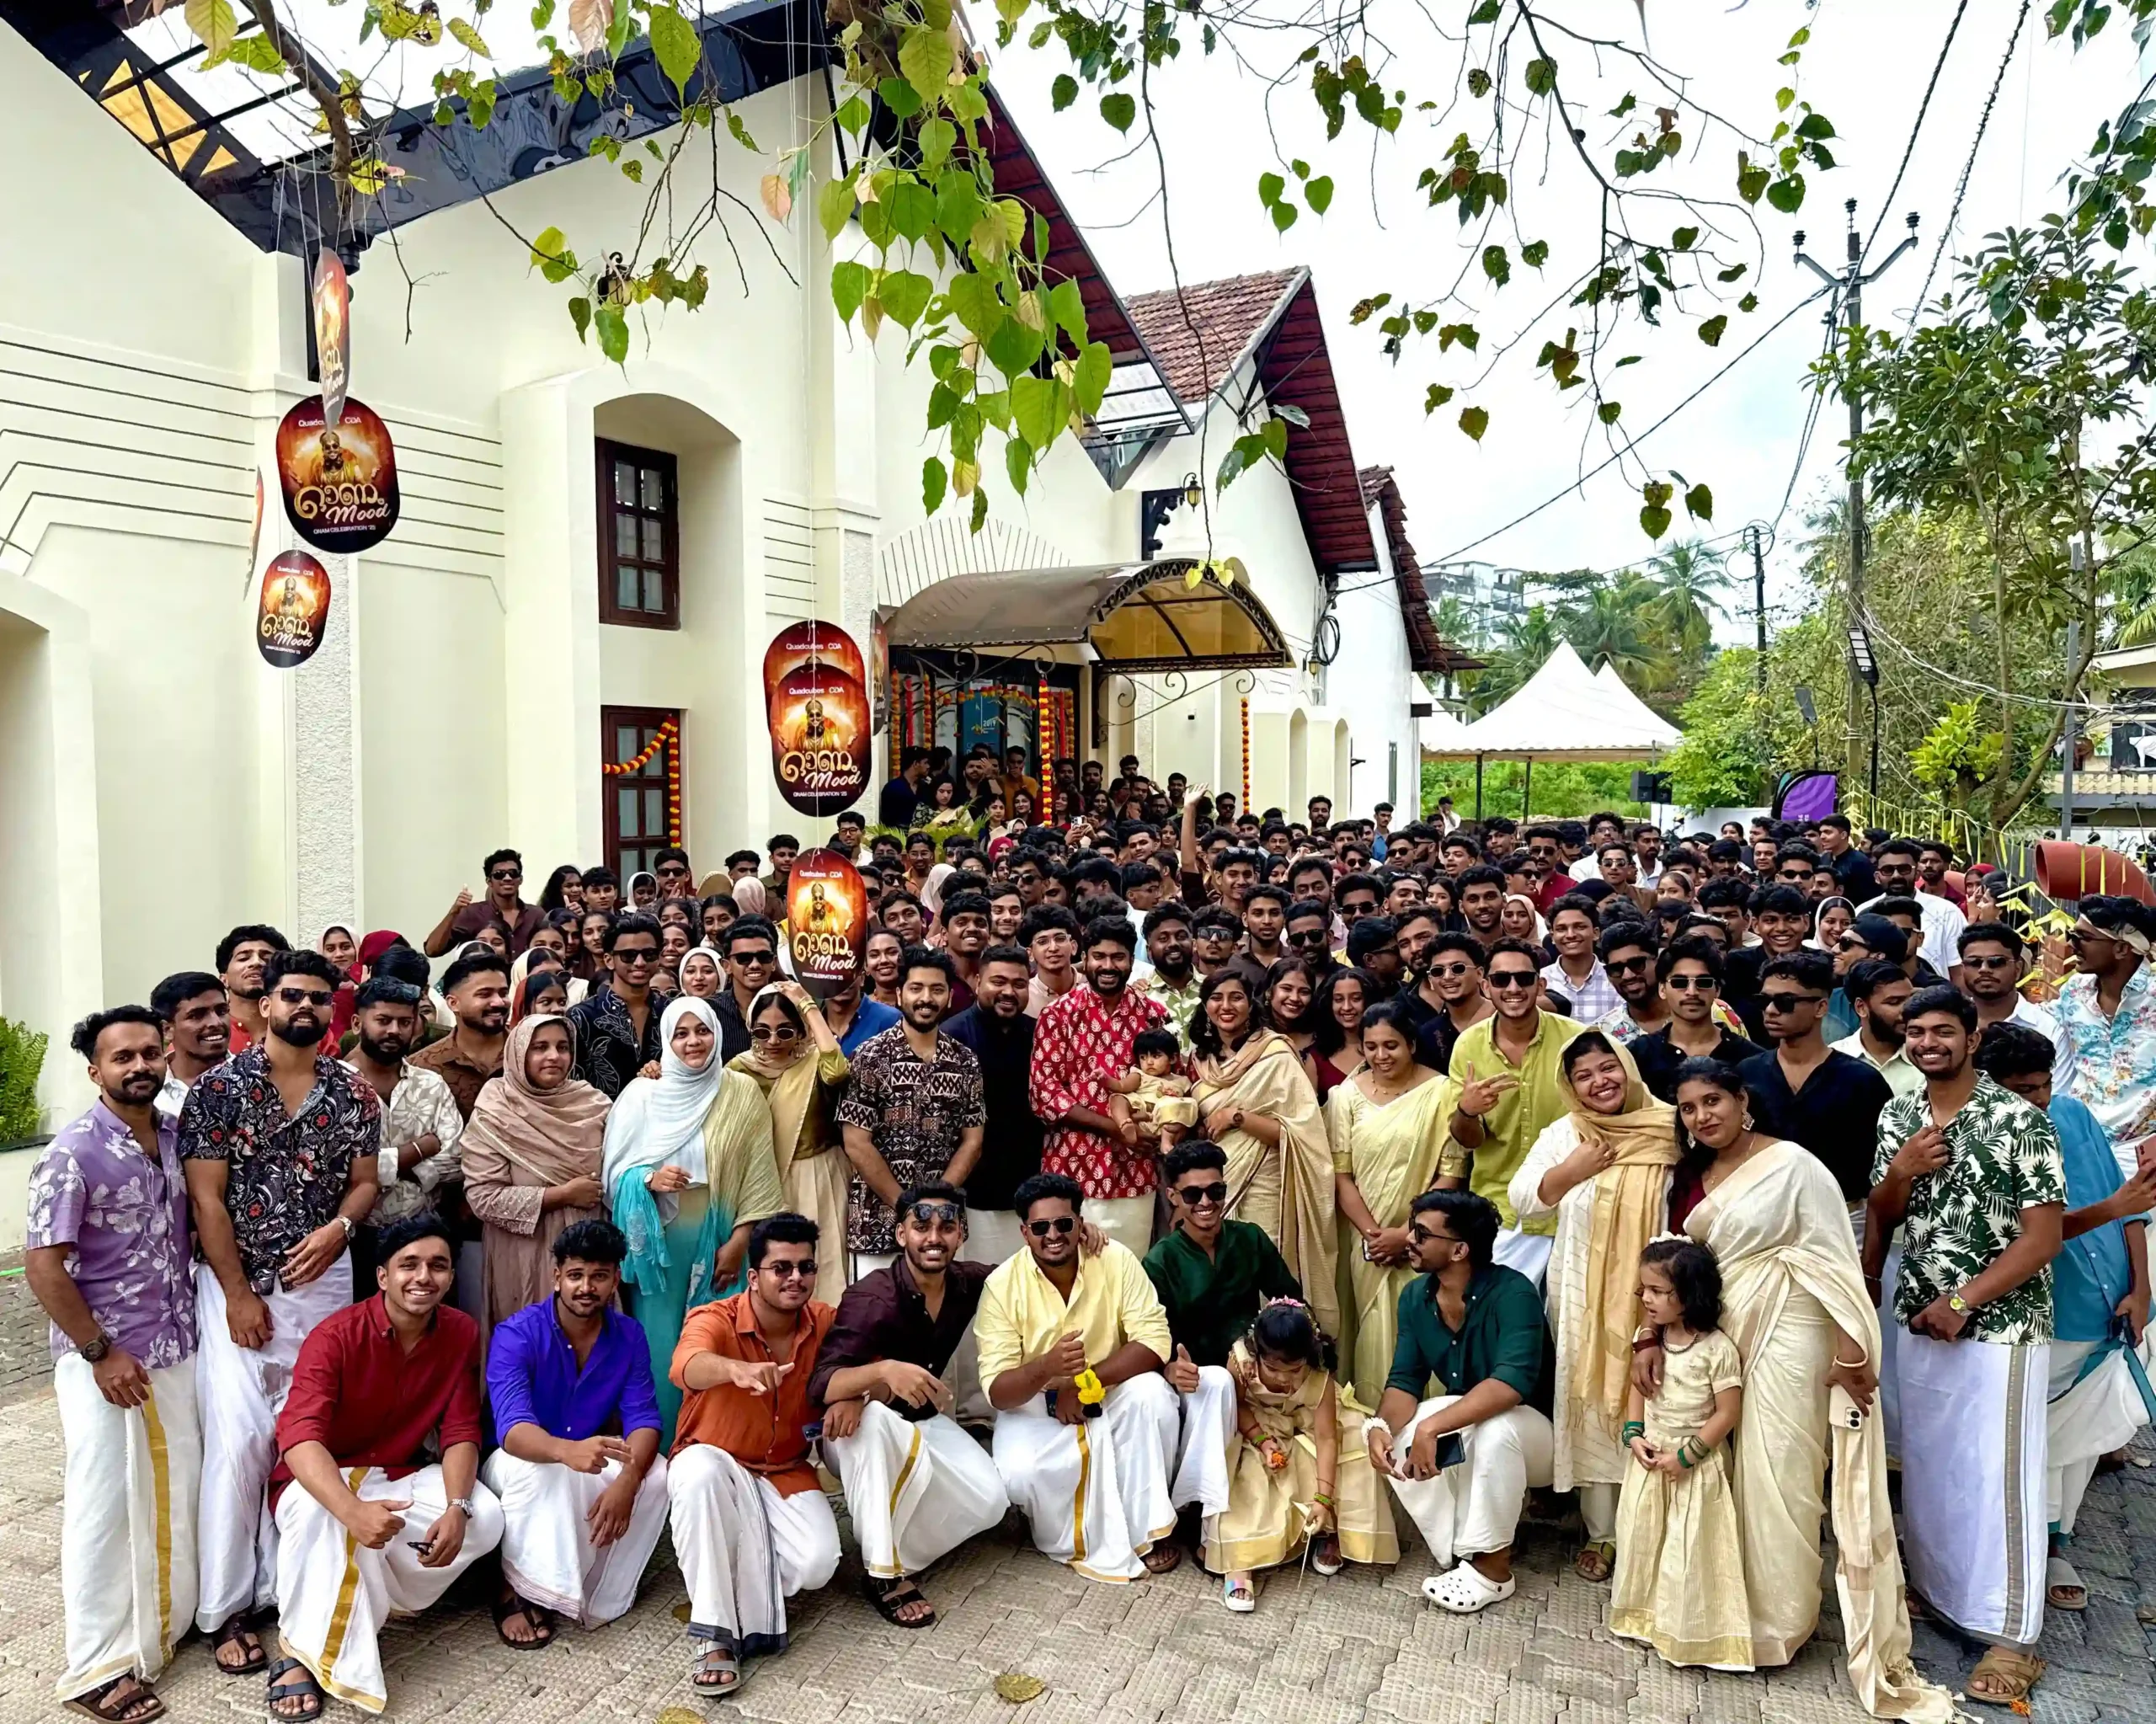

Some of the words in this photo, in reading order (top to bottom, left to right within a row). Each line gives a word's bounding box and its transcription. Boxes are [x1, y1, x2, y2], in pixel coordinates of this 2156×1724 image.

[344, 416, 362, 424] CDA
[325, 503, 391, 525] Mood
[330, 525, 367, 533] CELEBRATION
[274, 632, 314, 647] Mood
[803, 771, 862, 789] Mood
[809, 954, 857, 972] Mood
